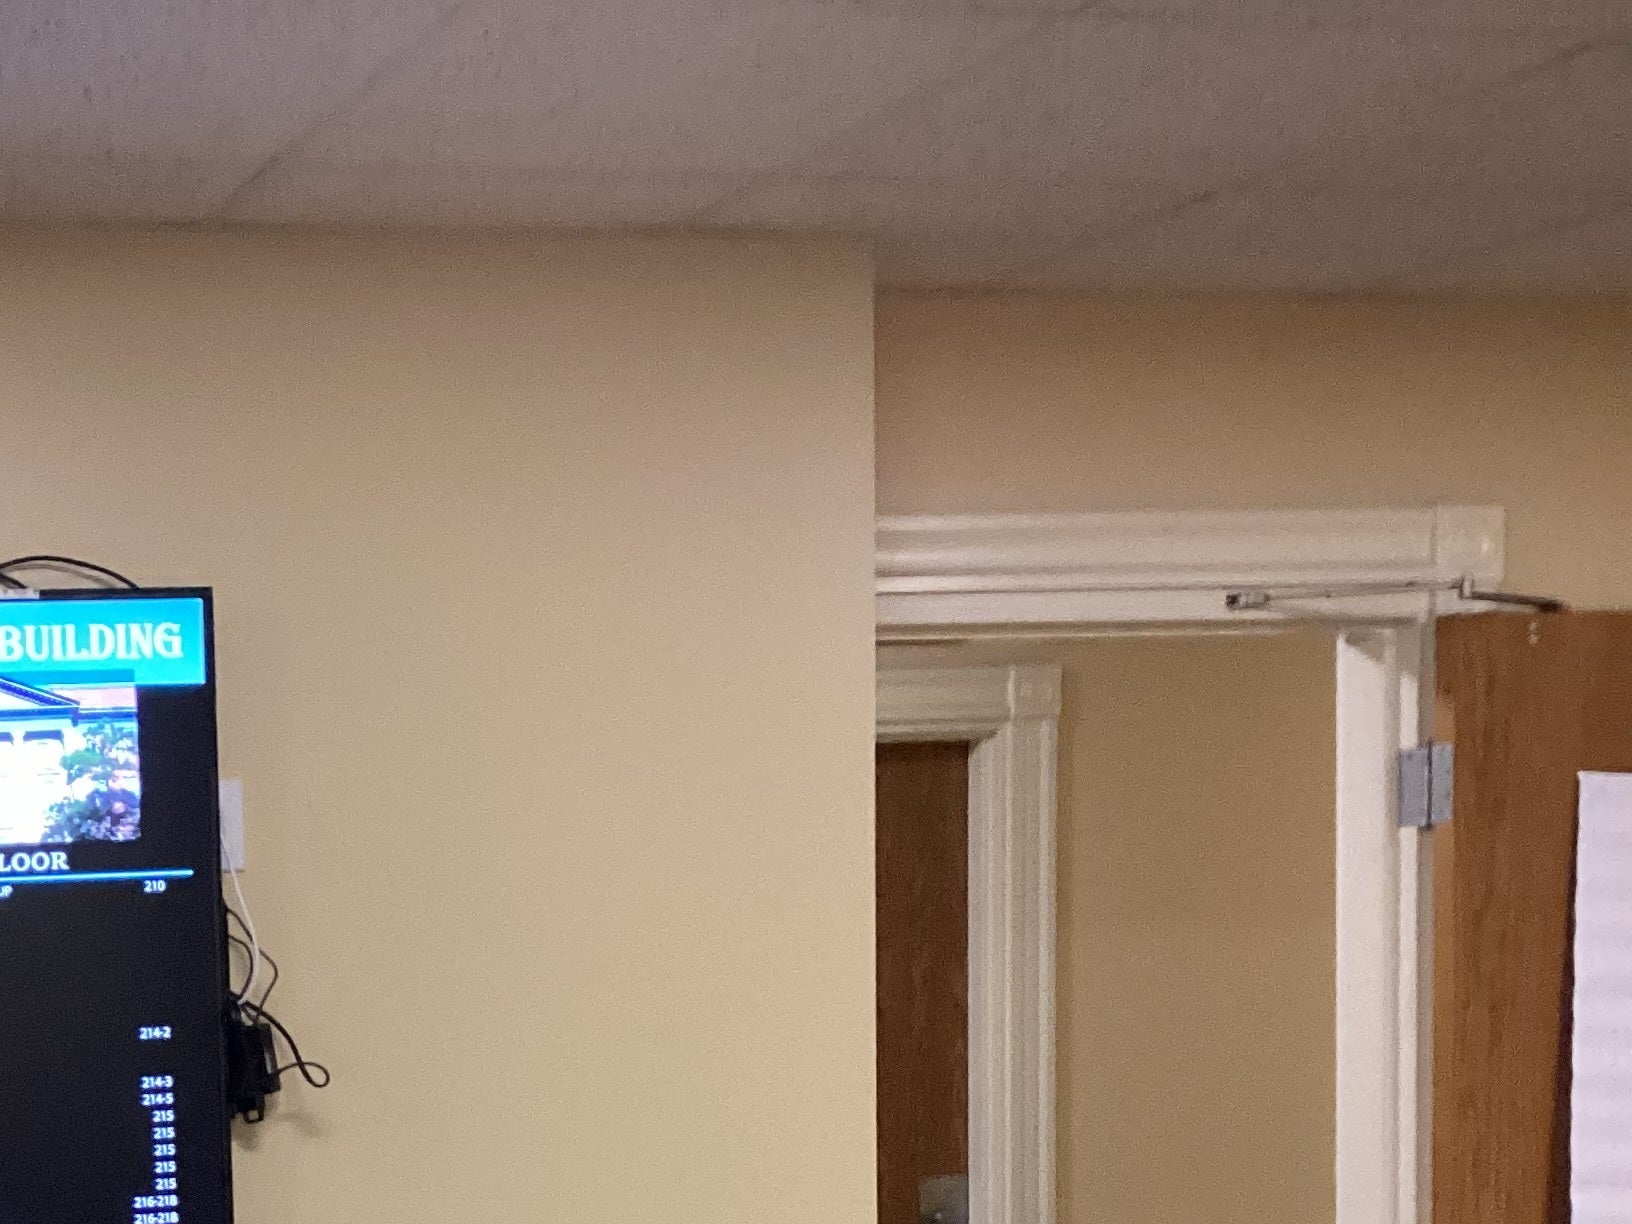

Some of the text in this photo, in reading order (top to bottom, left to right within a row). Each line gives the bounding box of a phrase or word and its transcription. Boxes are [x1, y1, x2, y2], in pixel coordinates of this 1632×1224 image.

[143, 880, 166, 893] 210
[139, 1026, 171, 1039] 214-2
[141, 1075, 173, 1088] 214-3
[141, 1093, 173, 1106] 214-5
[152, 1110, 174, 1122] 215
[153, 1127, 175, 1139] 215
[153, 1144, 176, 1156] 215
[154, 1161, 176, 1173] 215
[155, 1178, 177, 1190] 215
